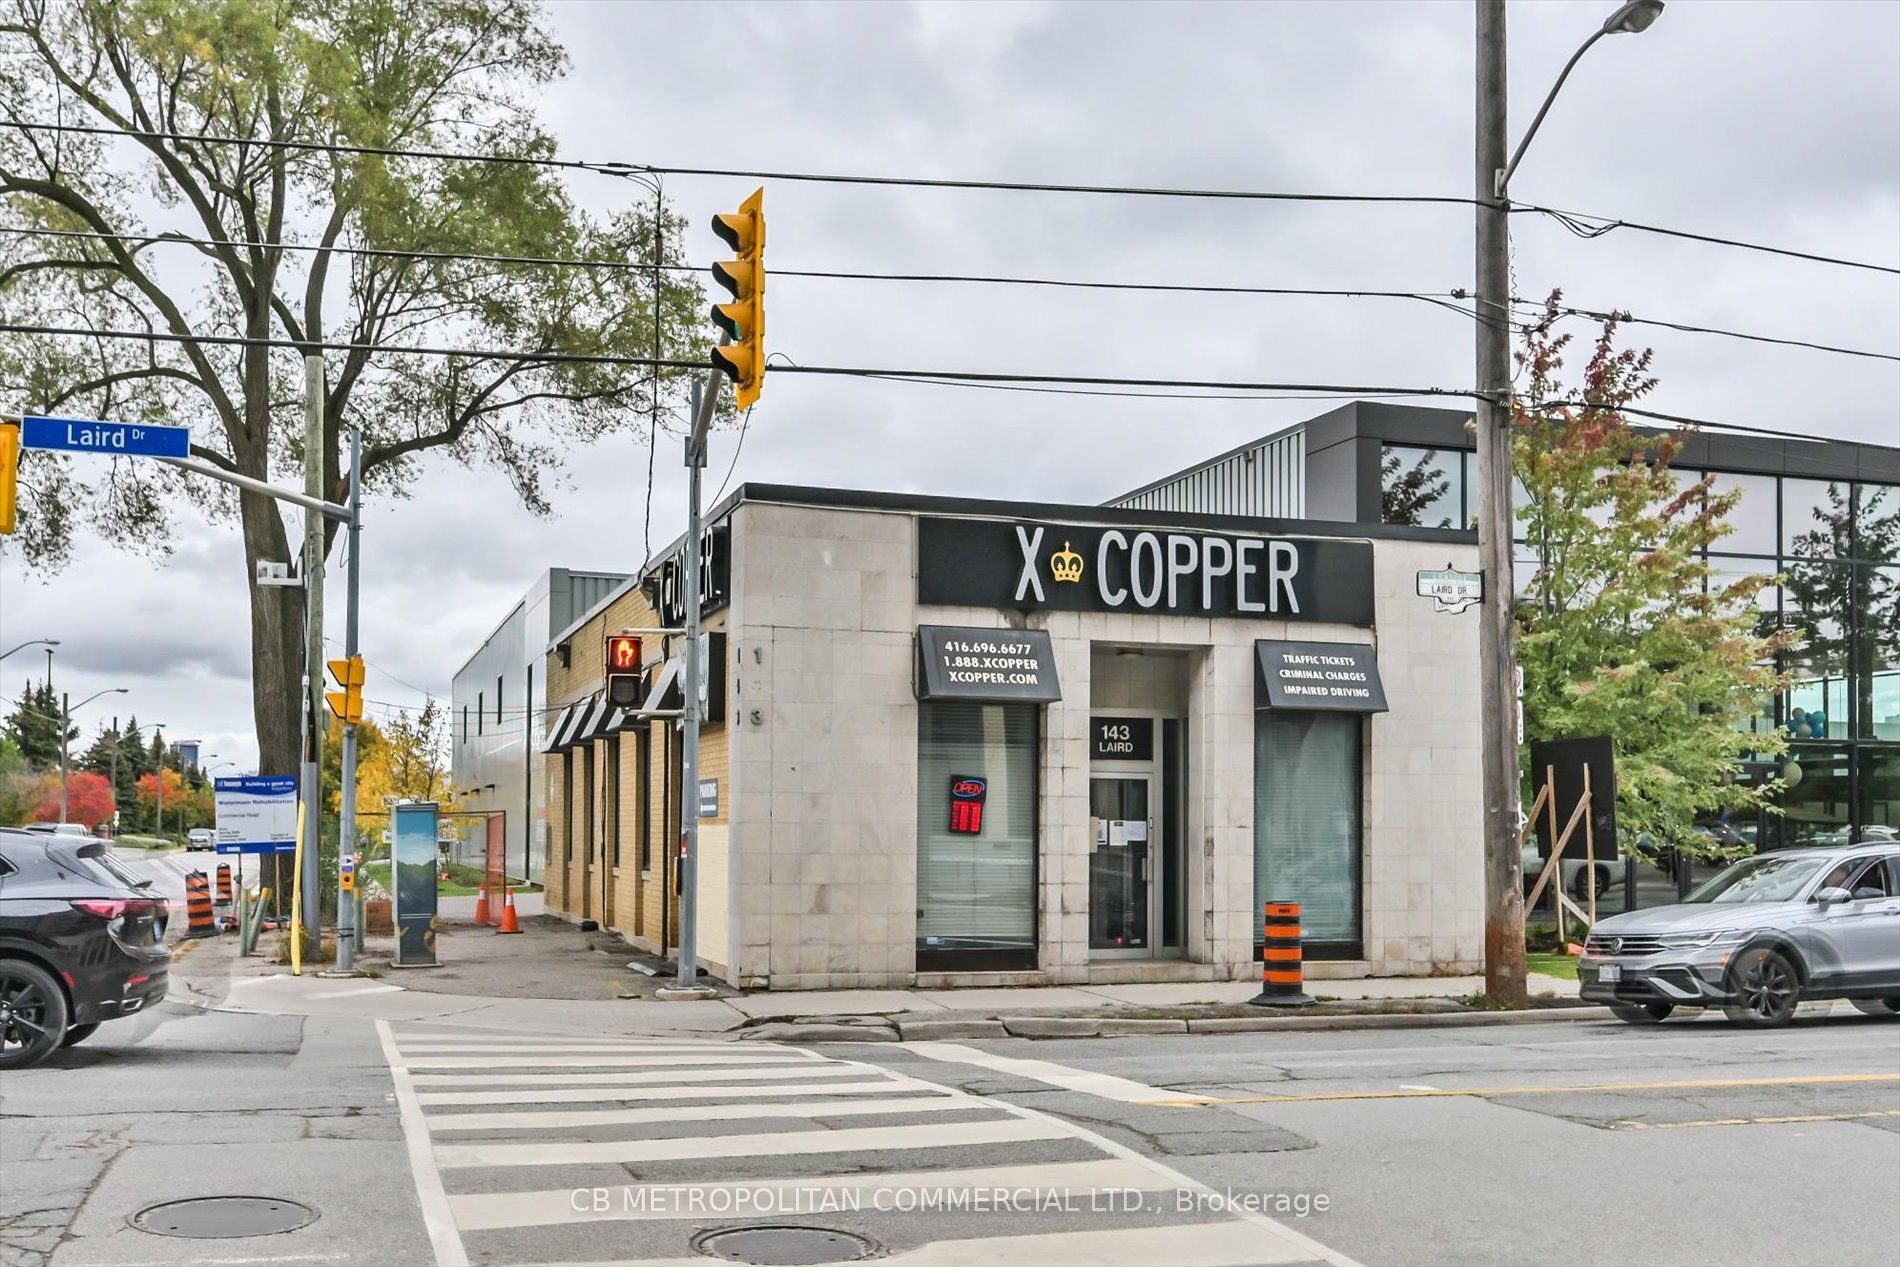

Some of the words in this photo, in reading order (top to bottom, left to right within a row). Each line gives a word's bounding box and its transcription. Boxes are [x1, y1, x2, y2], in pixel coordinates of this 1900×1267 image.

[67, 424, 125, 448] Laird
[132, 428, 146, 440] Dr
[1014, 525, 1046, 602] X
[1097, 529, 1300, 614] COPPER
[1431, 585, 1453, 594] LAIRD
[1457, 586, 1467, 595] DR
[944, 641, 1032, 654] 416.696.6677
[943, 656, 1039, 670] 1.888.XCOPPER
[1282, 654, 1320, 665] TRAFFIC
[1320, 656, 1355, 666] TICKETS
[948, 671, 1039, 685] XCOPPER.COM
[1279, 669, 1325, 680] CRIMINAL
[1325, 671, 1367, 682] CHARGES
[1283, 685, 1329, 696] IMPAIRED
[1330, 687, 1370, 698] DRIVING
[1100, 725, 1131, 740] 143
[1098, 741, 1134, 753] LAIRD
[953, 781, 983, 795] OPEN
